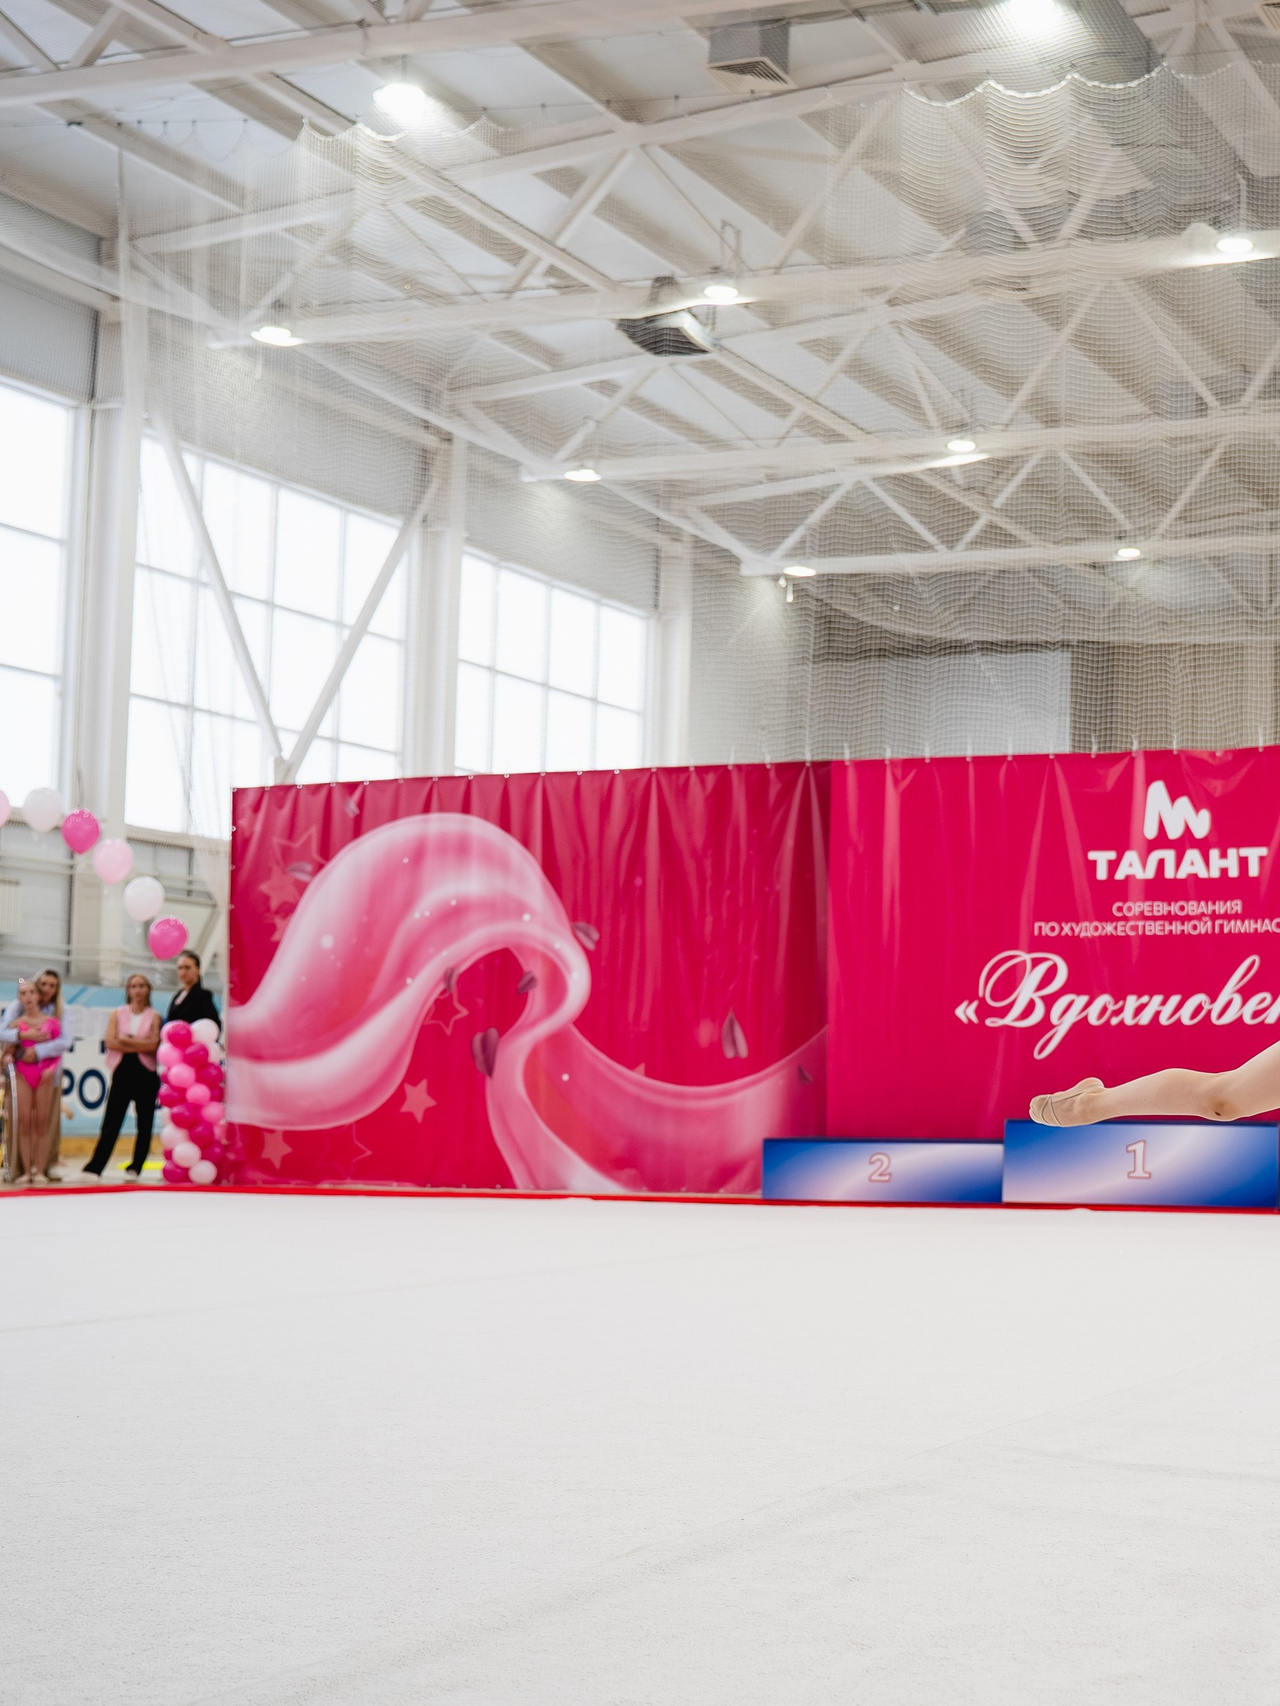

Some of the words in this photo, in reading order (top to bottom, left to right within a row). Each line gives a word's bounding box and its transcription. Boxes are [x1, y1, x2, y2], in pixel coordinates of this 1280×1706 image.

[1087, 847, 1269, 881] ТАЛАНТ
[1111, 899, 1243, 918] СОРЕВНОВАНИЯ
[1033, 921, 1060, 937] ПО
[1060, 917, 1212, 938] ХУДОЖЕСТВЕННОЙ
[867, 1152, 893, 1183] 2
[1125, 1138, 1152, 1180] 1
